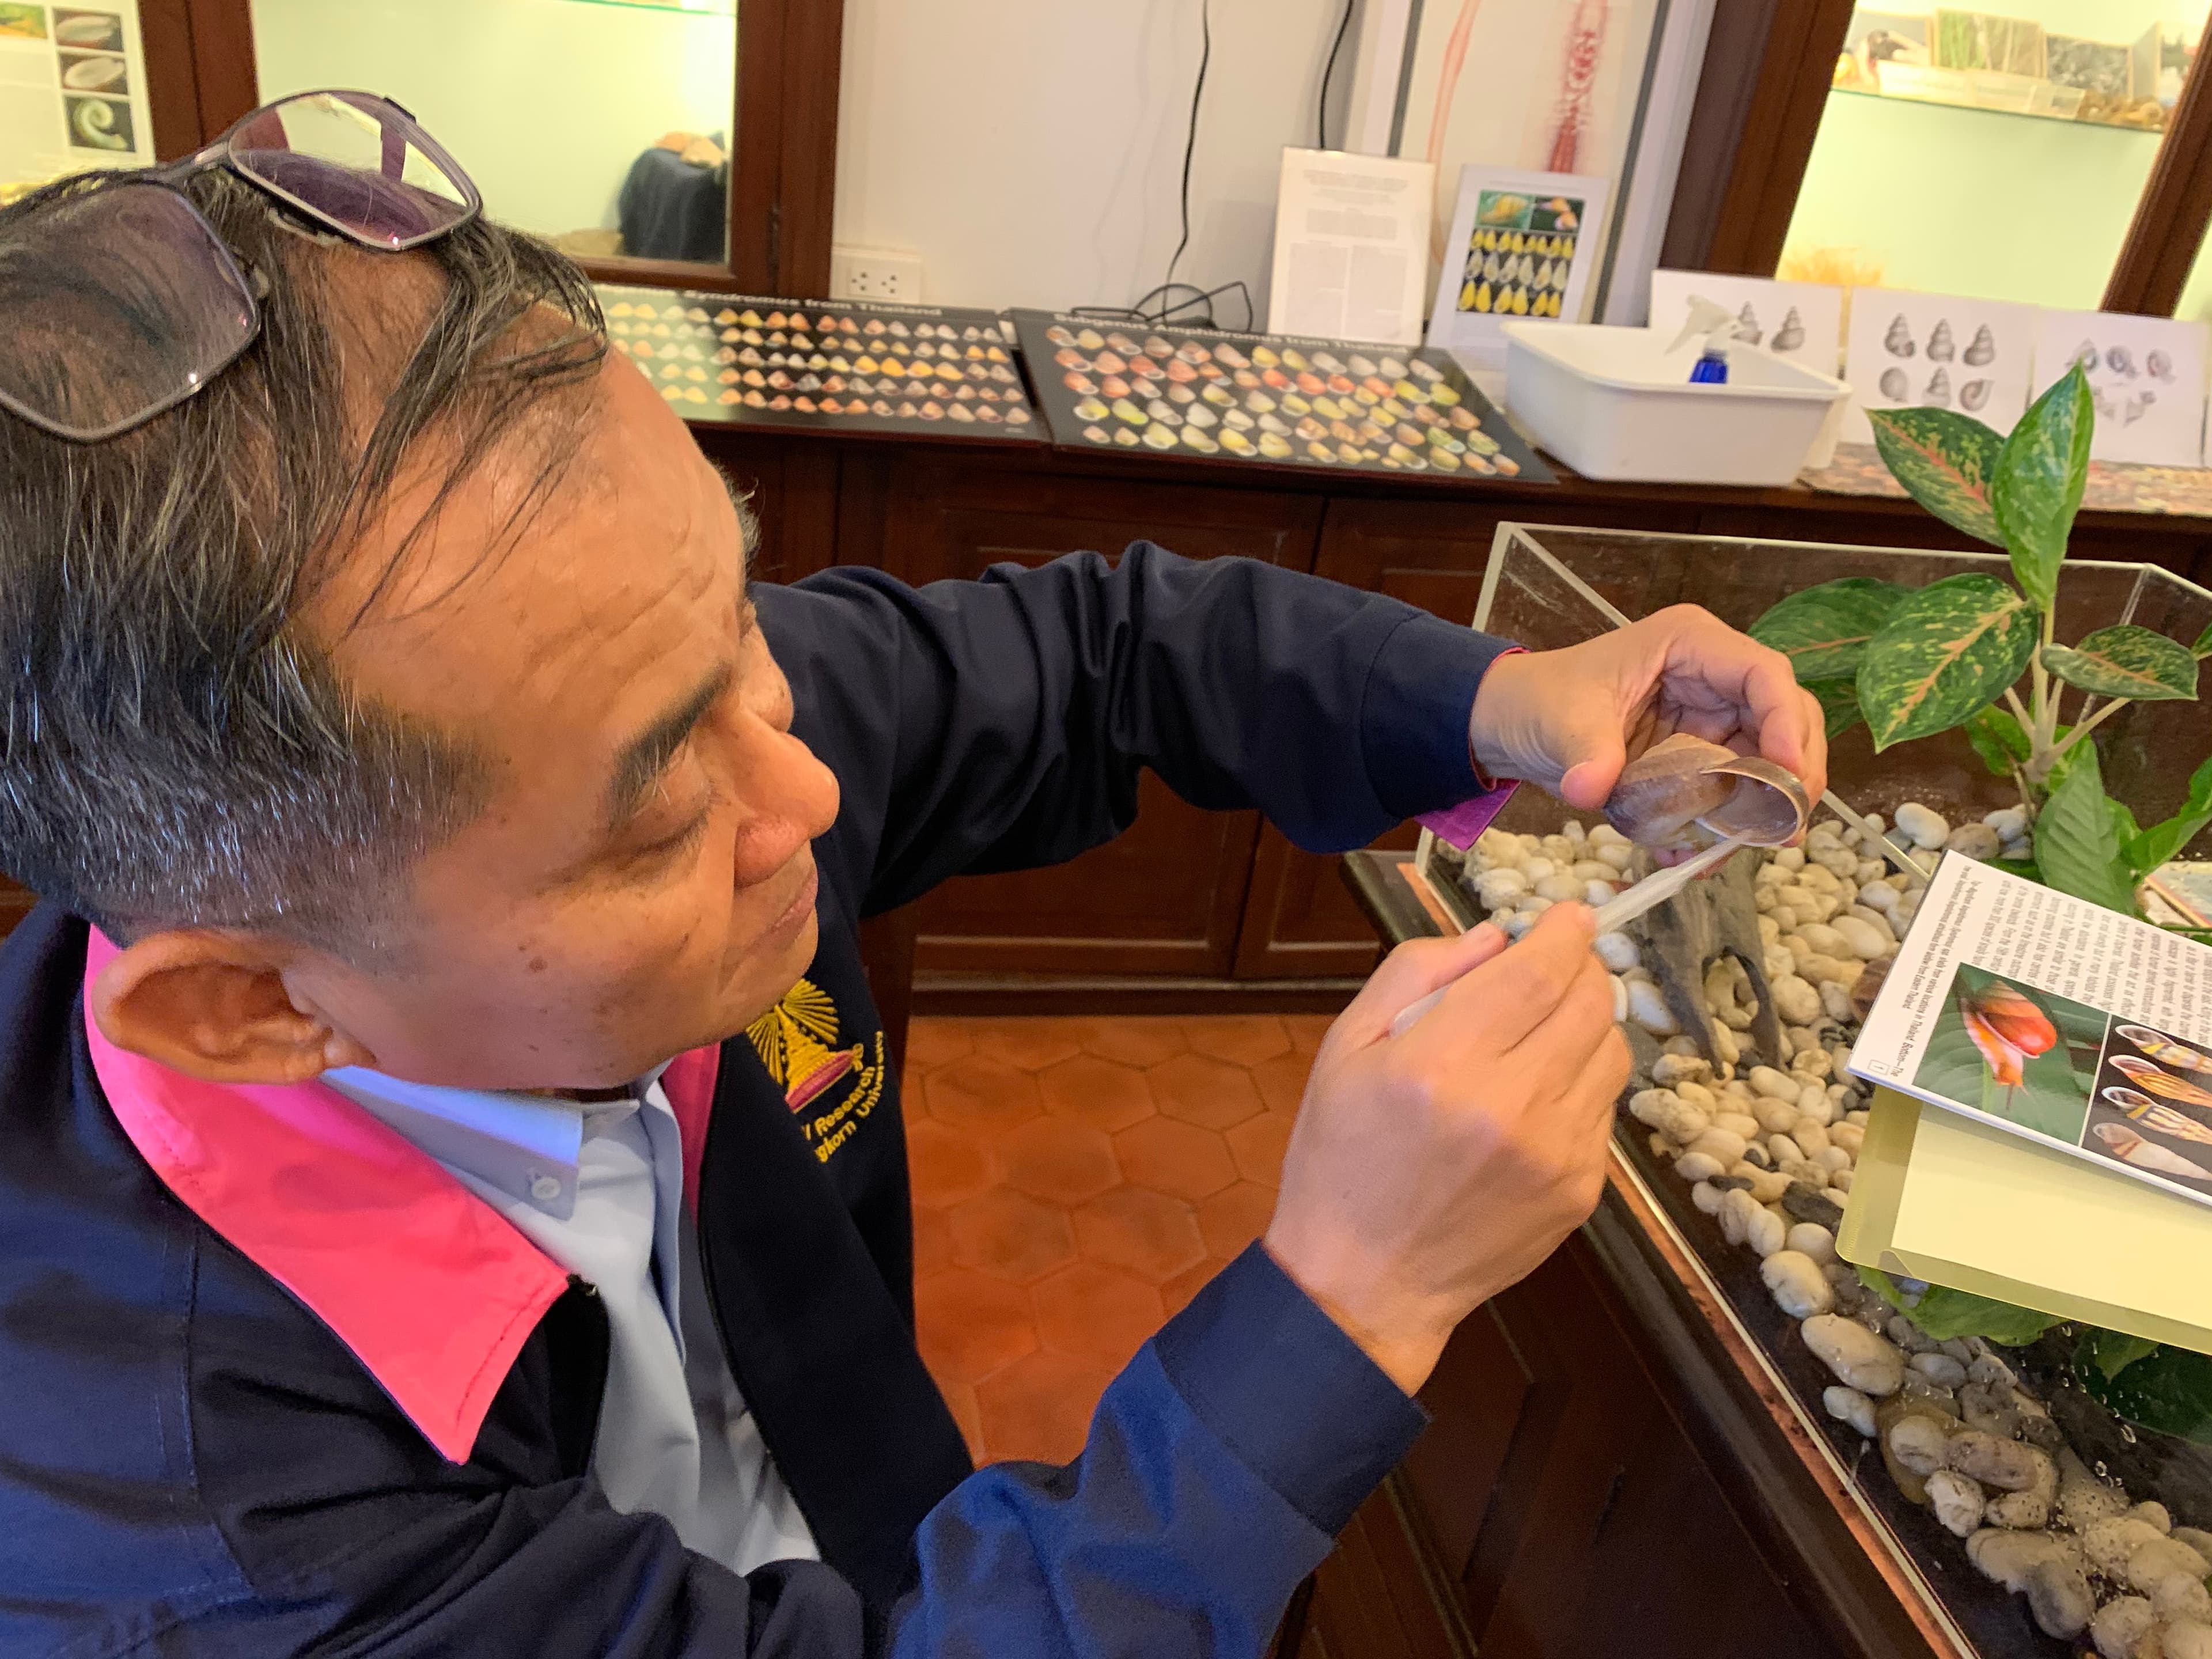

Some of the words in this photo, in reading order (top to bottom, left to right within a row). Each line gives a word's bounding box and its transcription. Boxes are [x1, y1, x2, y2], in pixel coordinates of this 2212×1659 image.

[805, 298, 853, 310] from
[859, 302, 943, 316] Thailand
[1054, 313, 1150, 331] Subgenus
[1154, 324, 1282, 343] Amphidromus
[815, 1066, 876, 1137] Research
